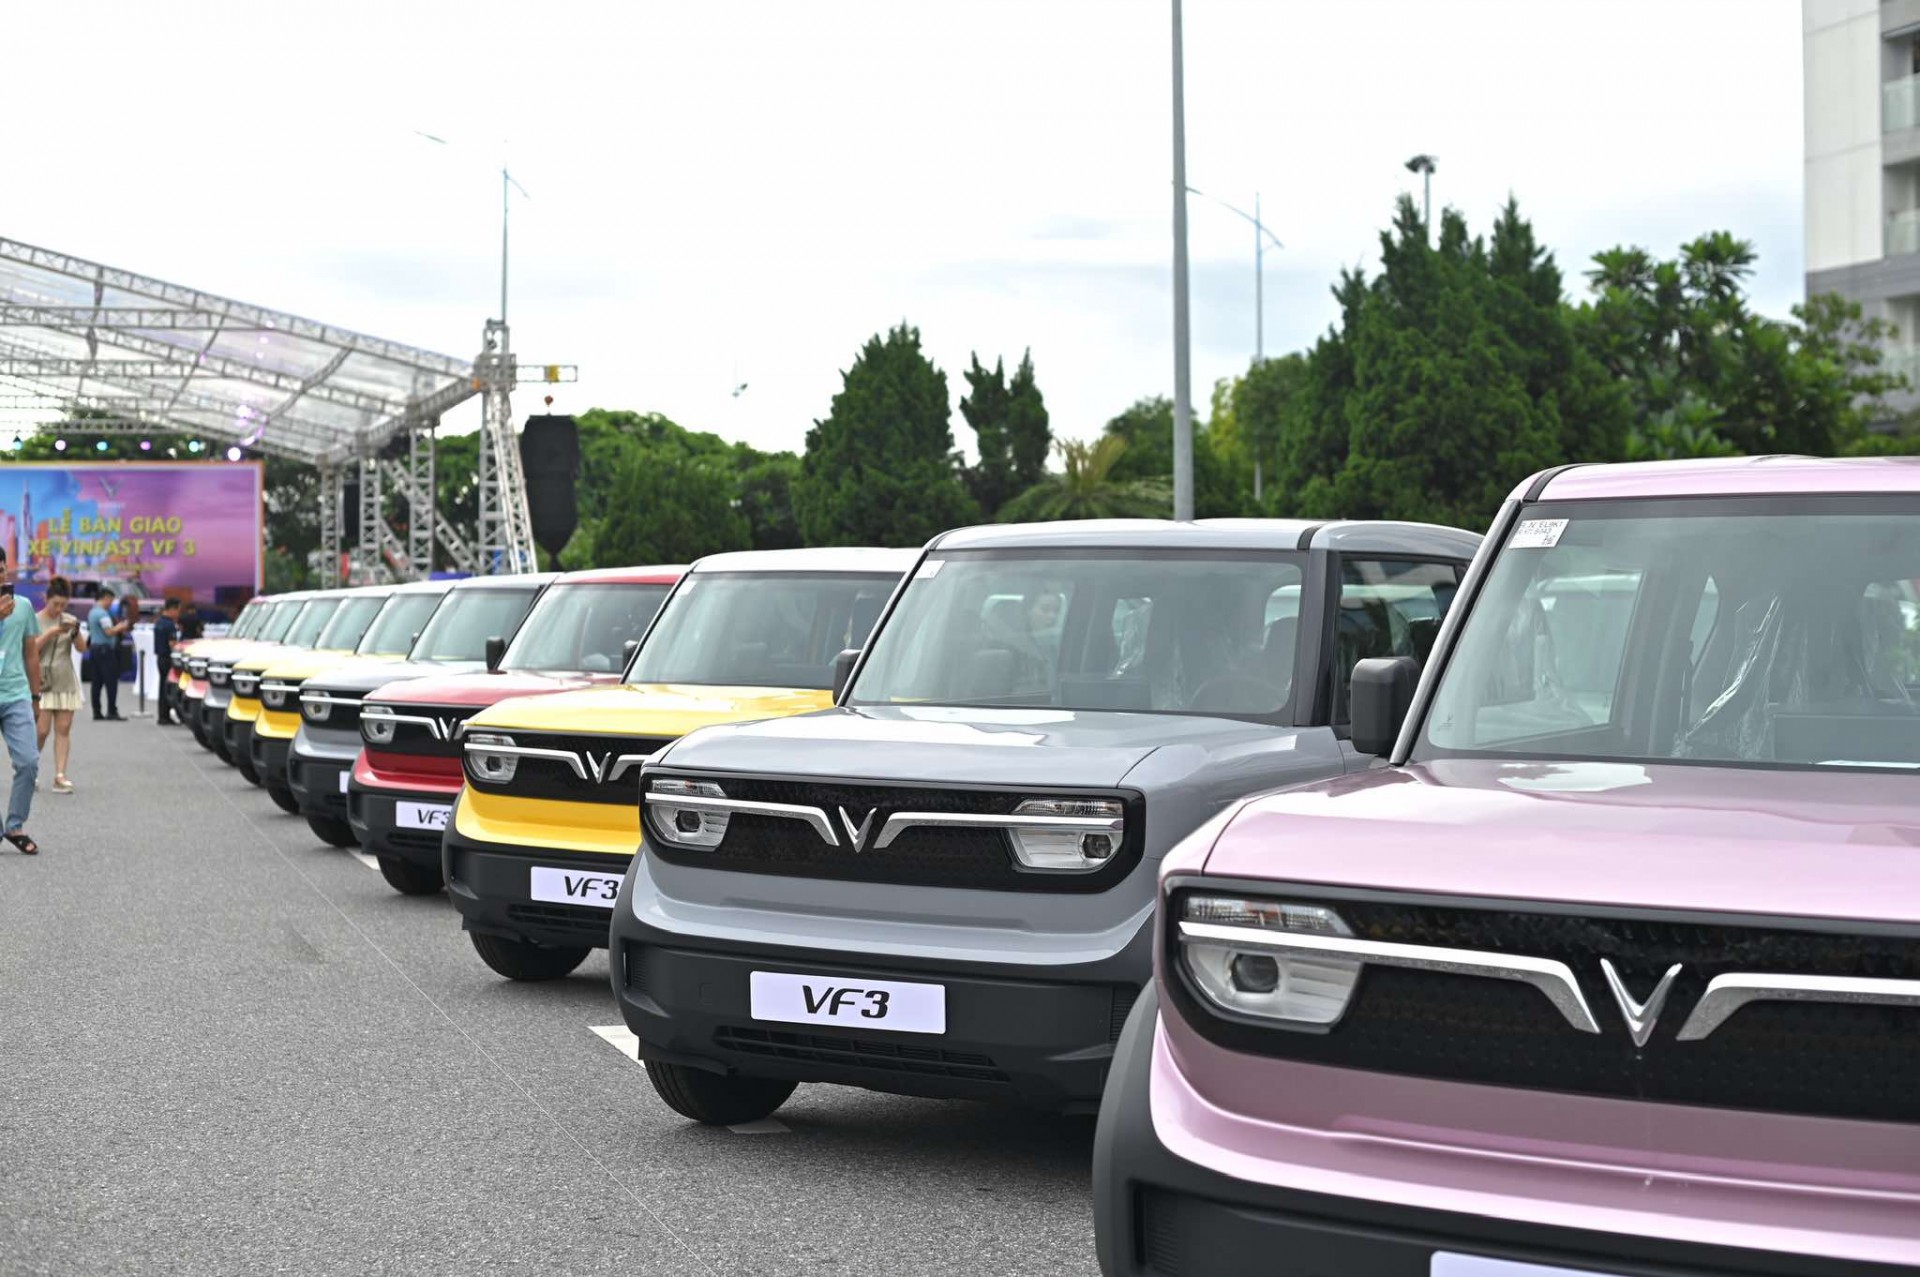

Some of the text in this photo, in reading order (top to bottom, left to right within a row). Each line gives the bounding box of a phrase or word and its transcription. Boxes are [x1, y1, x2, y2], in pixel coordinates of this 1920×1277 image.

[129, 515, 182, 534] GIAO
[28, 538, 196, 557] XE VINFAST VF 3
[564, 875, 619, 900] VF3
[802, 985, 890, 1019] VF3
